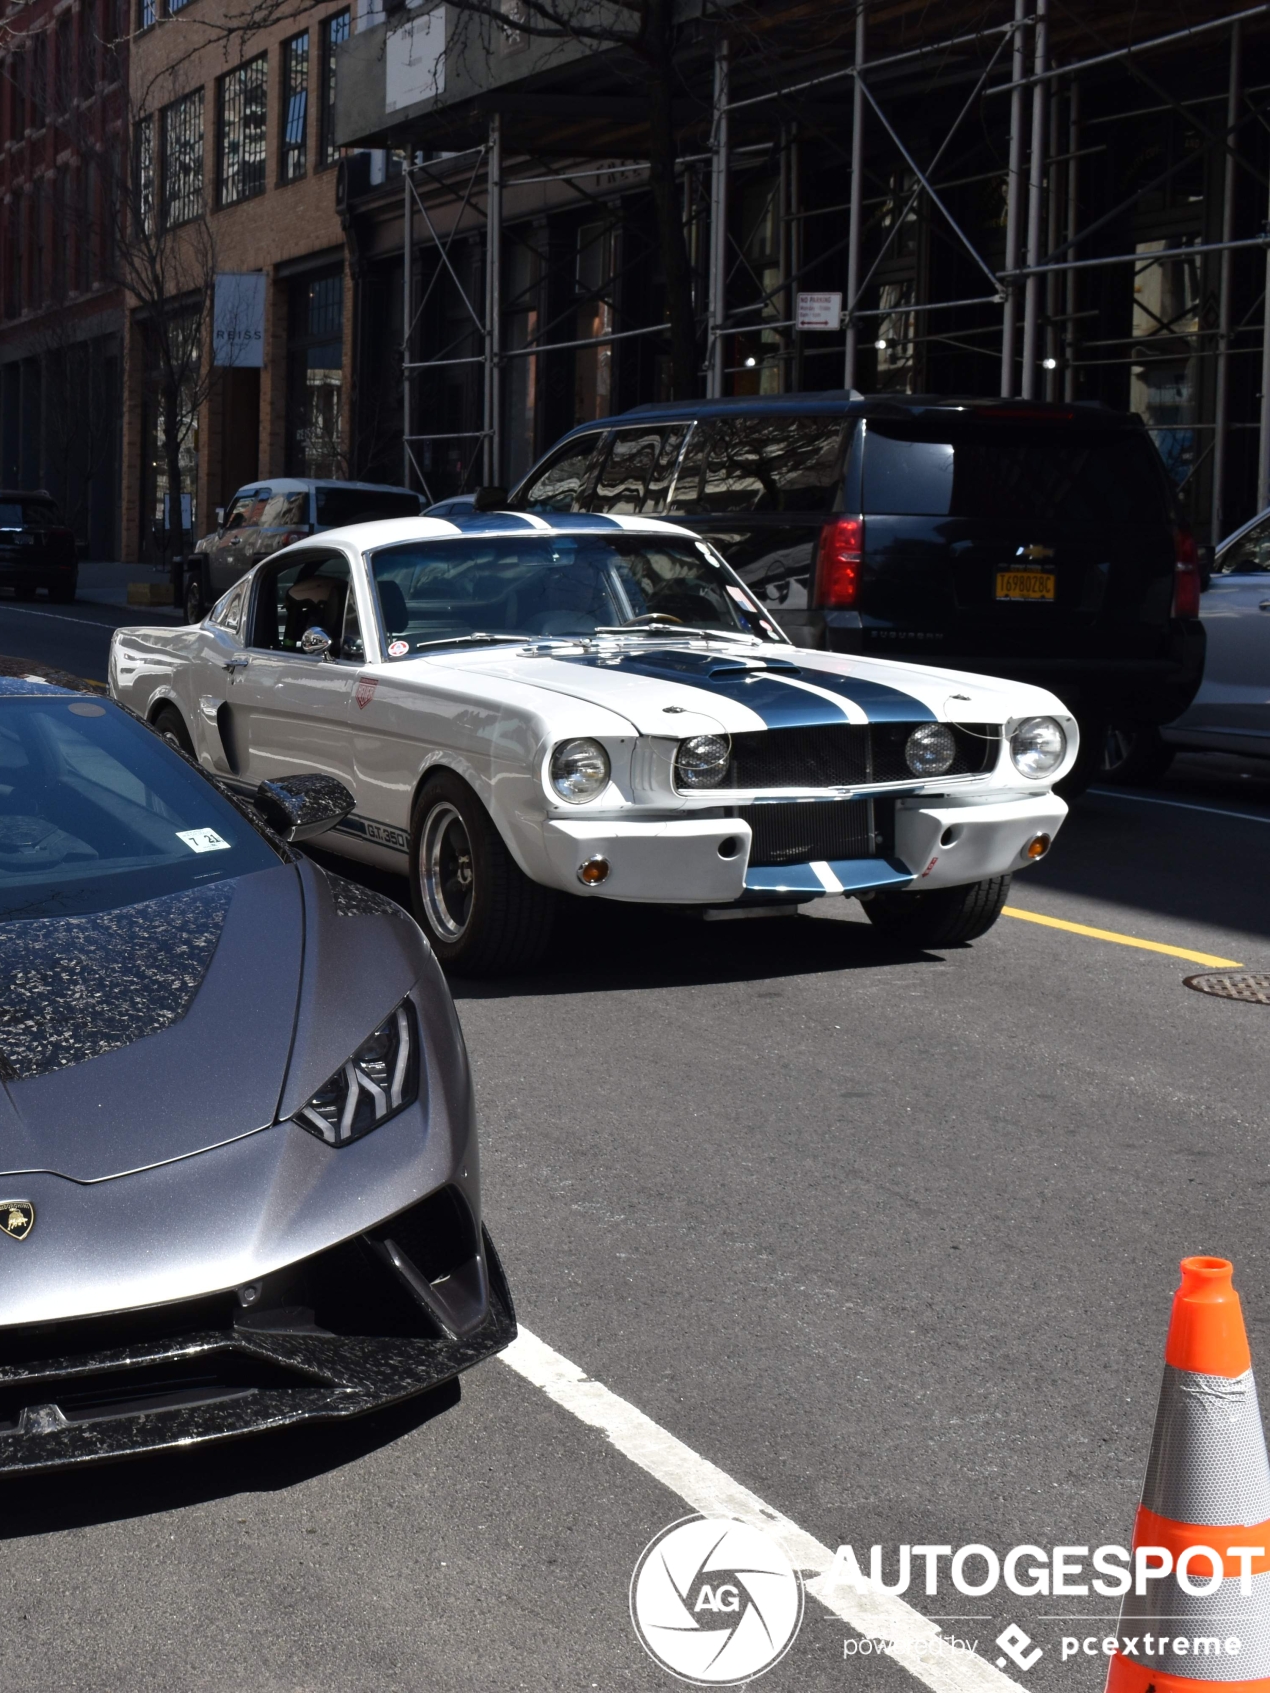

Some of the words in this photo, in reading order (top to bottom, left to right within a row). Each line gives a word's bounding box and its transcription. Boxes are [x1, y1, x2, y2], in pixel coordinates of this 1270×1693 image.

[216, 330, 262, 340] REISS
[188, 837, 199, 846] 7
[203, 834, 221, 844] 21
